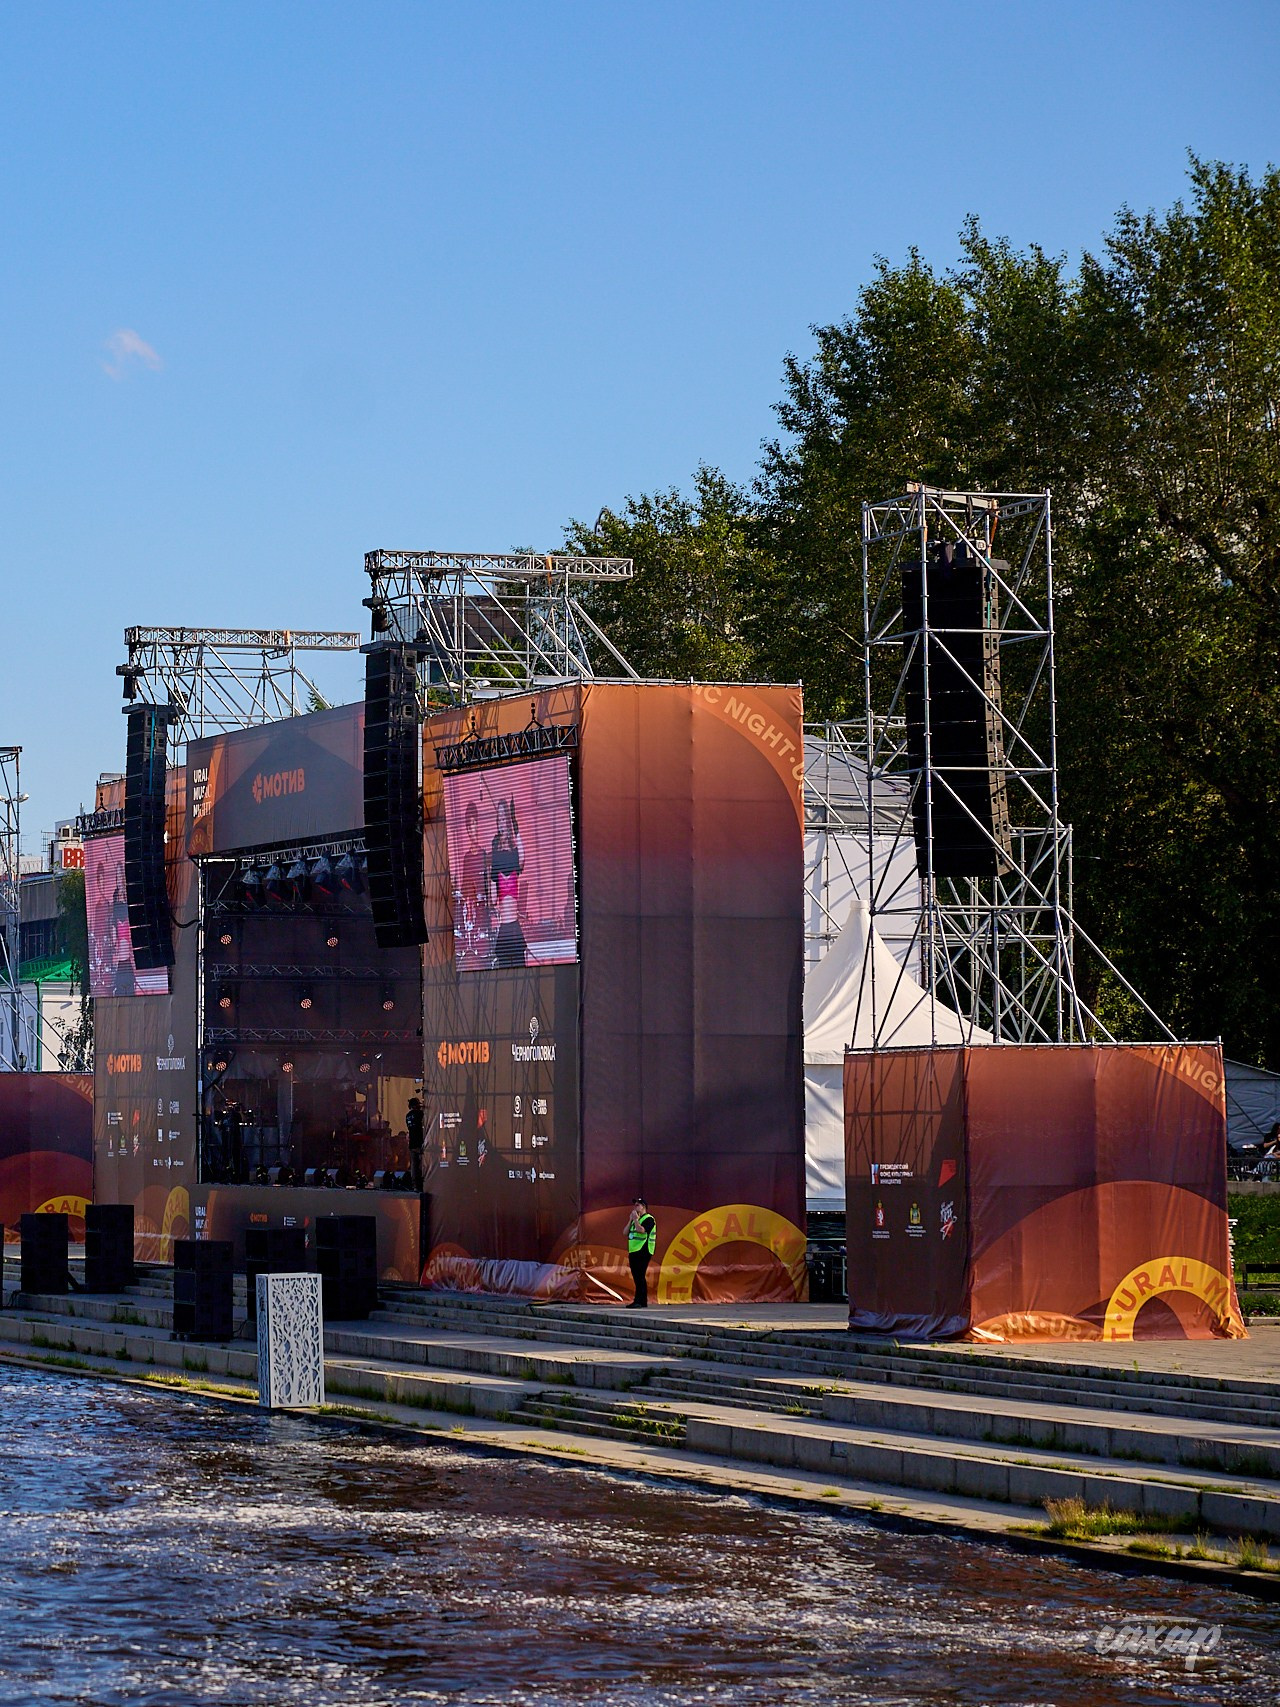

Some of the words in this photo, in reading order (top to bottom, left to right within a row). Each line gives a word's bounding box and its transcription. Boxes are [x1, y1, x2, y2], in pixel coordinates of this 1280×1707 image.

[724, 696, 796, 757] NIGHT
[193, 768, 209, 783] URAL
[263, 768, 305, 798] МОТИВ
[114, 1055, 142, 1072] МОТИВ
[448, 1041, 489, 1064] МОТИВ
[512, 1044, 556, 1061] ЧЕРНОГОЛОВКА
[672, 1213, 762, 1264] URAL
[1115, 1264, 1194, 1312] URAL
